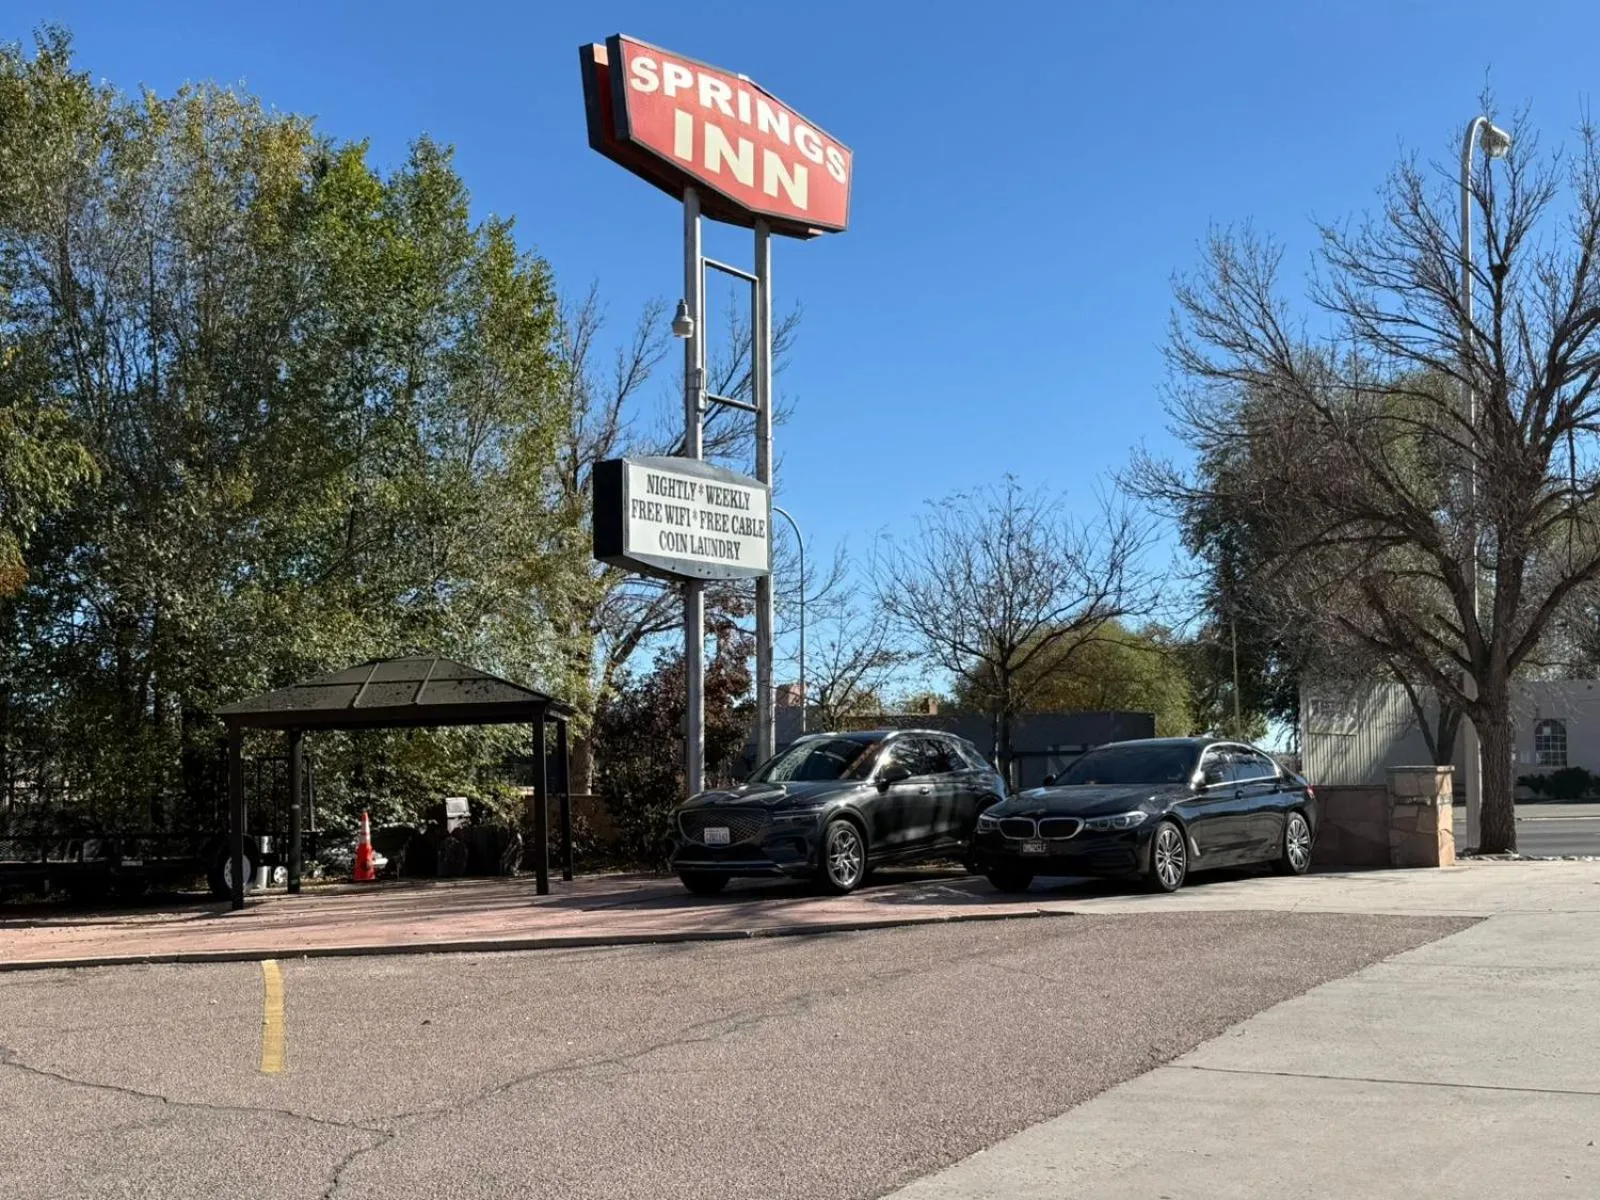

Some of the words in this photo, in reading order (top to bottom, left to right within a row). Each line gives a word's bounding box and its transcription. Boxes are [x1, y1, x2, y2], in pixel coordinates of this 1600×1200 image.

[630, 56, 847, 184] SPRINGS
[674, 108, 808, 211] INN
[646, 474, 697, 502] NIGHTLY
[706, 484, 750, 511] WEEKLY
[632, 499, 662, 523] FREE
[665, 504, 691, 528] WIFI
[700, 510, 729, 533] FREE
[732, 516, 765, 538] CABLE
[659, 530, 688, 554] COIN
[690, 534, 741, 560] LAUNDRY
